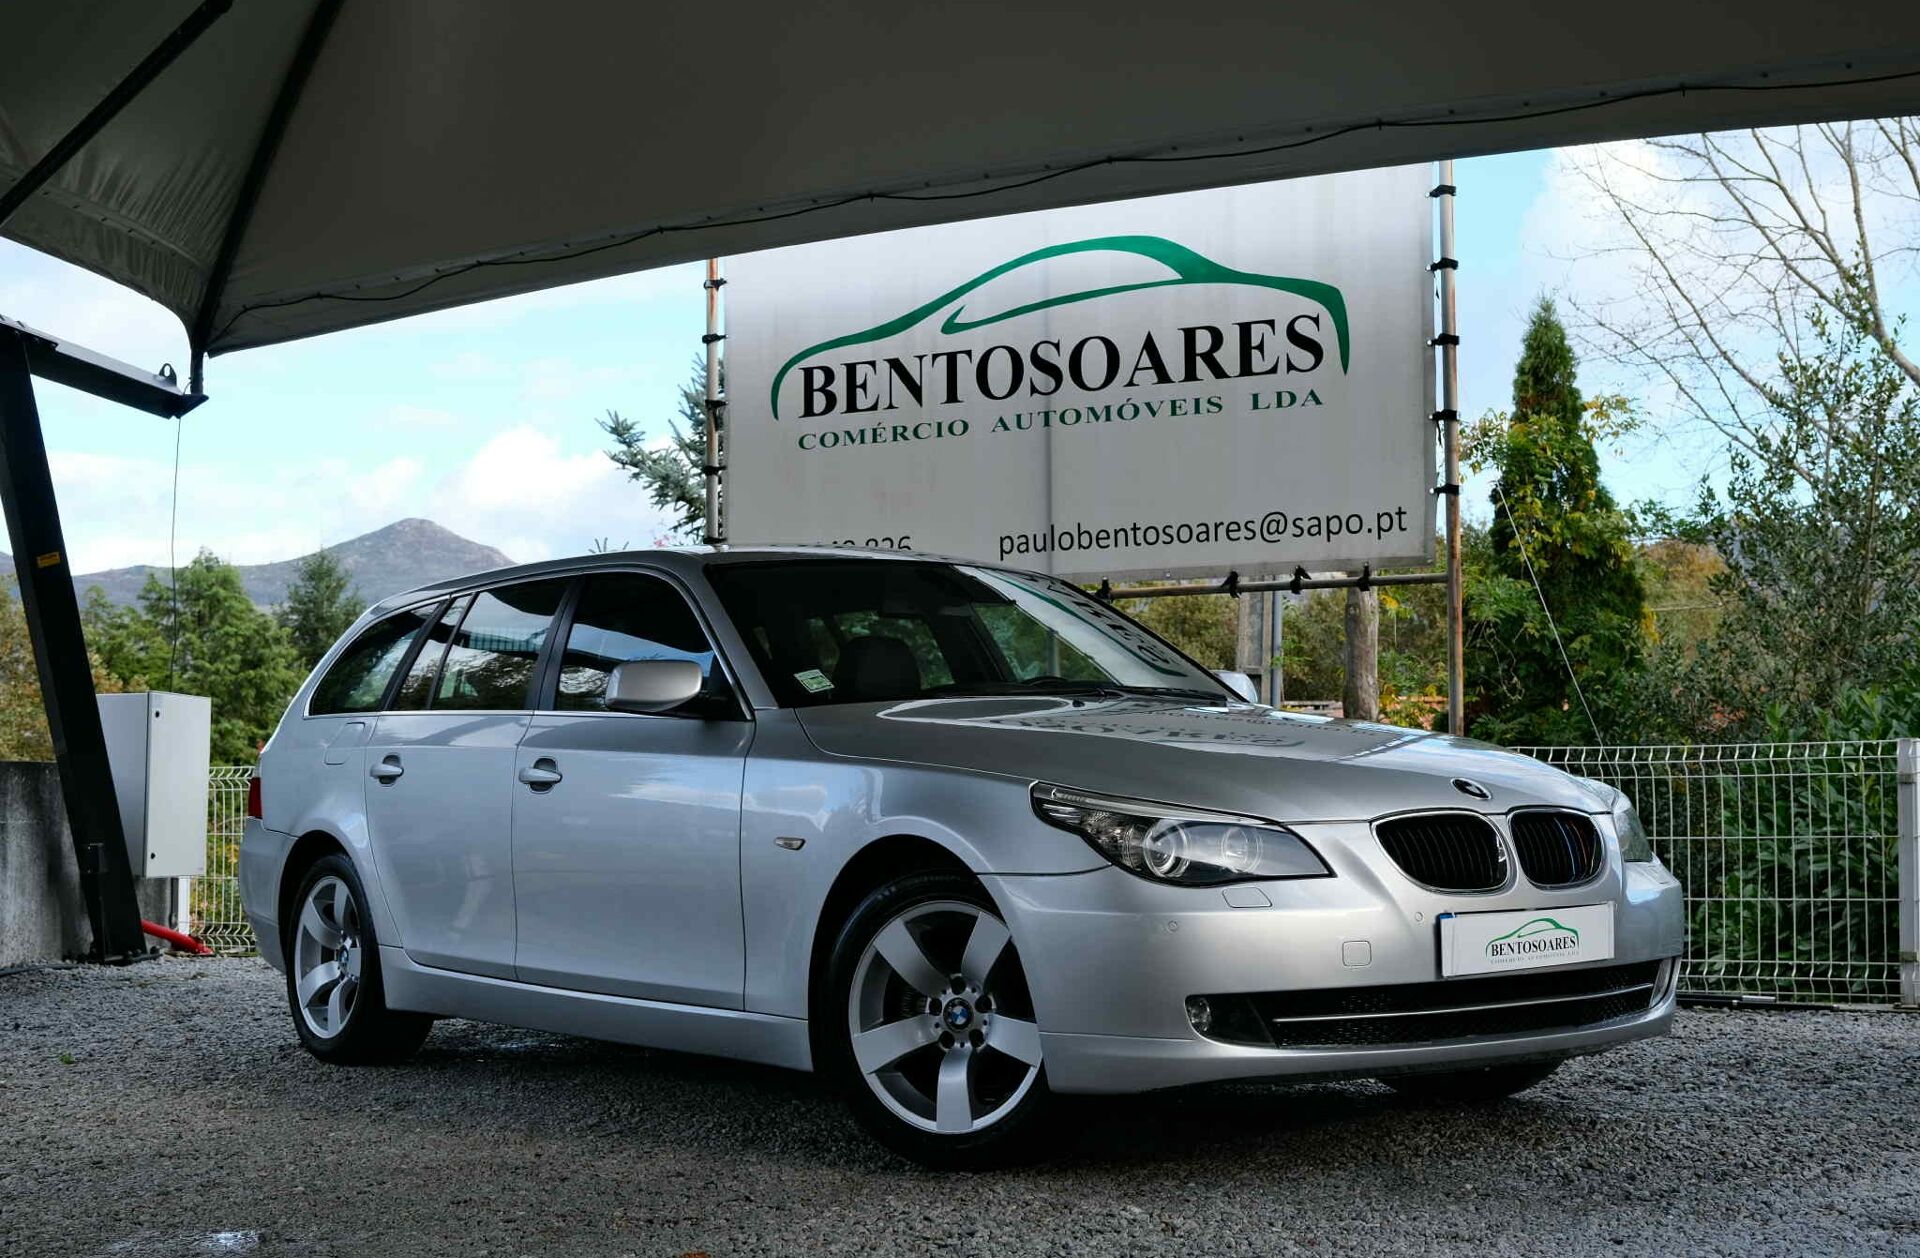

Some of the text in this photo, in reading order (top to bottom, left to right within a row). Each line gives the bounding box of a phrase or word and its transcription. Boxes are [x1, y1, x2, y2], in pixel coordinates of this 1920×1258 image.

[798, 313, 1326, 418] BENTOSOARES
[798, 389, 1324, 452] COMÉRCIO AUTOMÓVEIS LDA
[998, 505, 1408, 561] paulobentosoares@sapo.pt
[1491, 935, 1576, 957] BENTOSOARES
